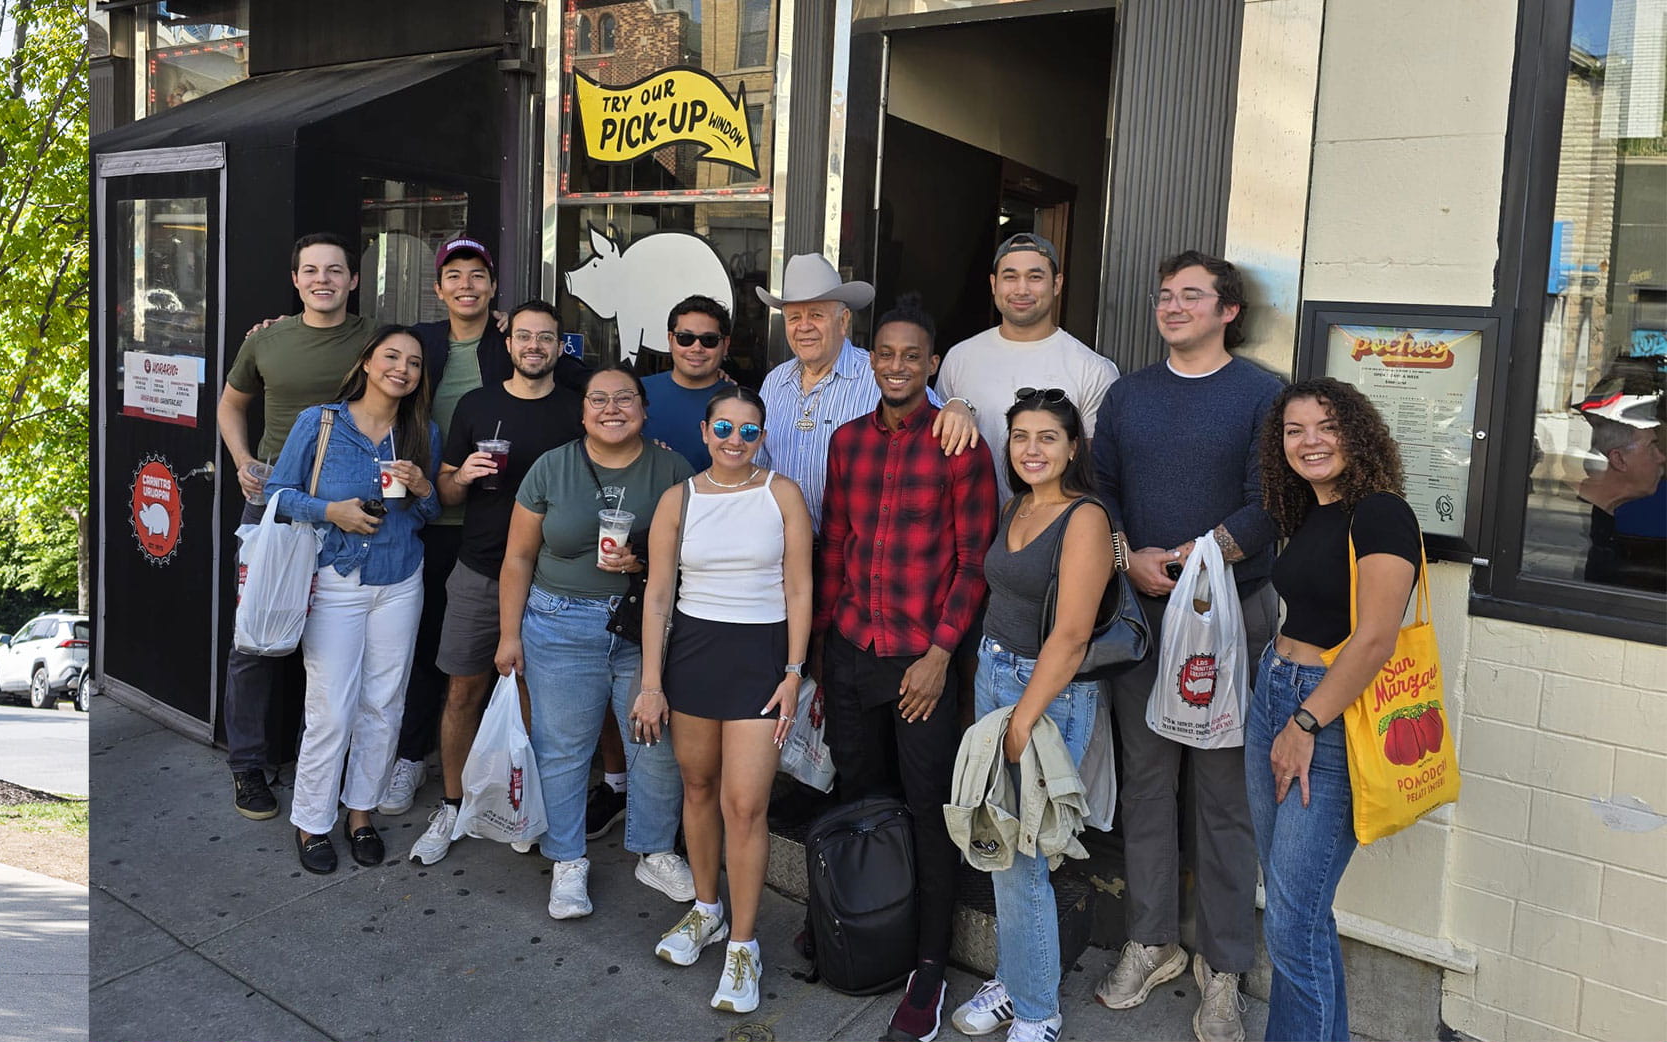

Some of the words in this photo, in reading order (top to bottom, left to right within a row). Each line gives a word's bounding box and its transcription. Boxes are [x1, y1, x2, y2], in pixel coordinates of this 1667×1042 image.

[602, 95, 633, 113] TRY
[641, 78, 676, 106] OUR
[600, 99, 708, 152] PICK-UP
[708, 111, 746, 148] WINDOW
[1373, 663, 1438, 713] Marzan
[1382, 656, 1416, 683] San
